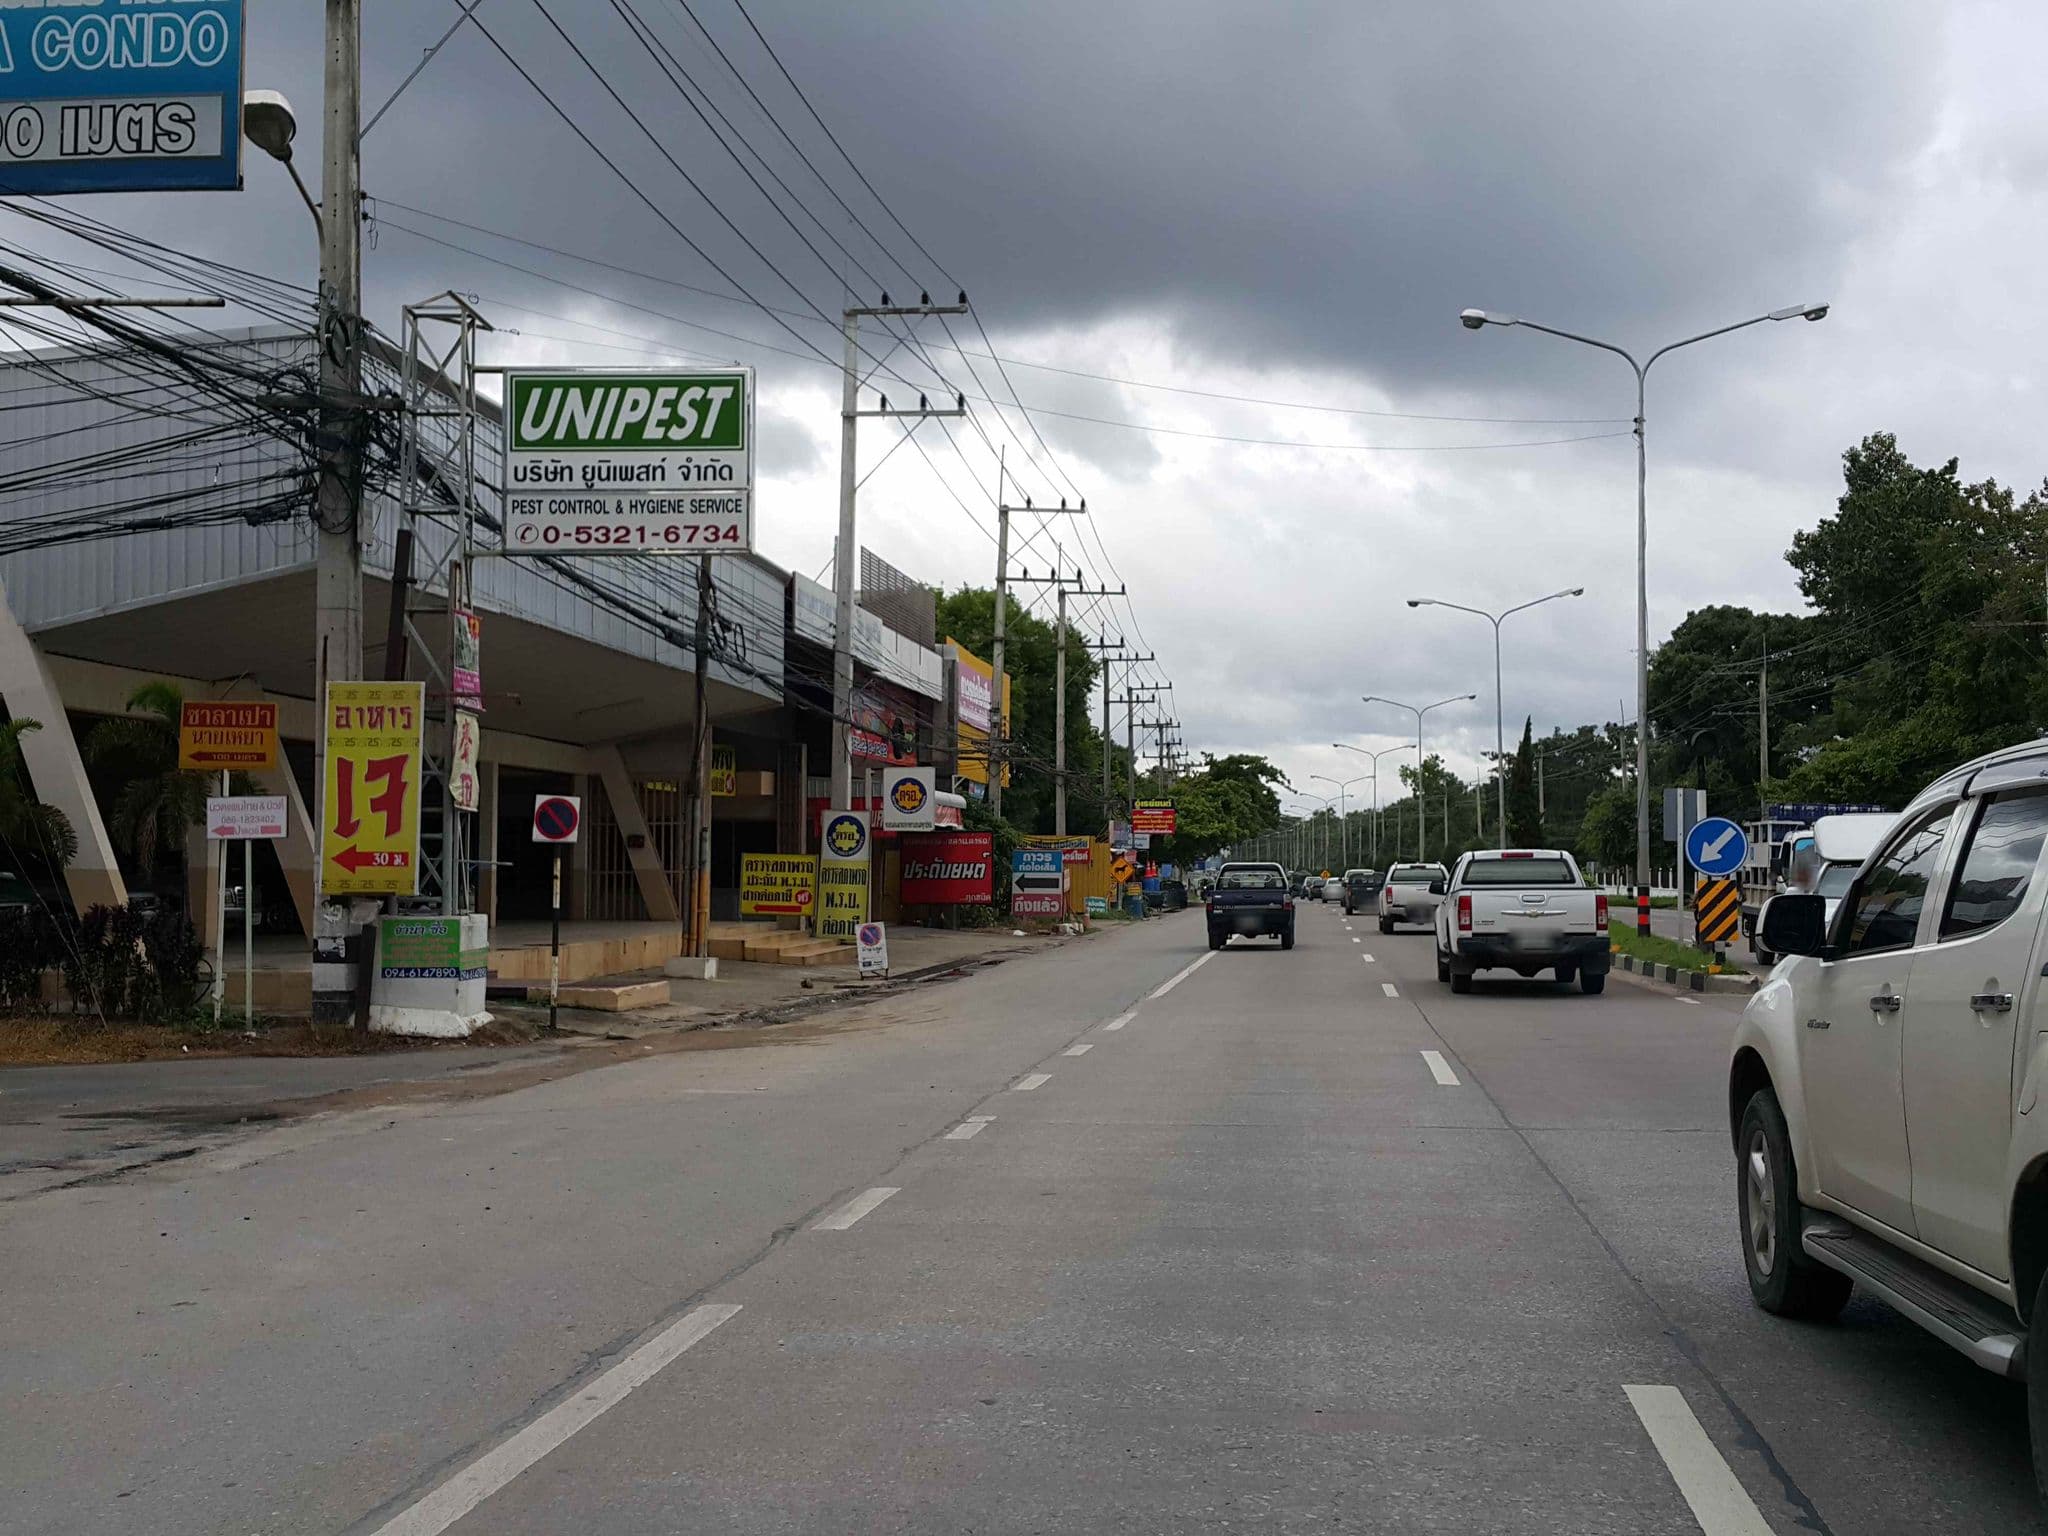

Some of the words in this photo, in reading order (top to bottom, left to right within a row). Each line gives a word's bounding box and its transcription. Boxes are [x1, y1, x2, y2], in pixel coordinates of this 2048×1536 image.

[32, 10, 229, 71] CONDO
[60, 101, 196, 156] เมตร
[520, 386, 734, 441] UNIPEST
[514, 459, 573, 482] บริษัท
[581, 457, 667, 488] ยูนิเพสท์
[678, 457, 733, 482] จำกัด
[512, 500, 544, 514] PEST
[549, 500, 610, 514] CONTROL
[615, 500, 624, 514] &
[630, 499, 685, 514] HYGIENE
[690, 498, 742, 514] SERVICE
[543, 524, 740, 544] 0-5321-6734
[335, 705, 412, 731] อาหาร
[333, 754, 409, 839] เจ
[372, 853, 389, 865] 30
[904, 852, 990, 879] ประดับยนต์
[826, 892, 860, 909] พ.ร.บ.
[1014, 896, 1060, 913] ถึงแล้ว
